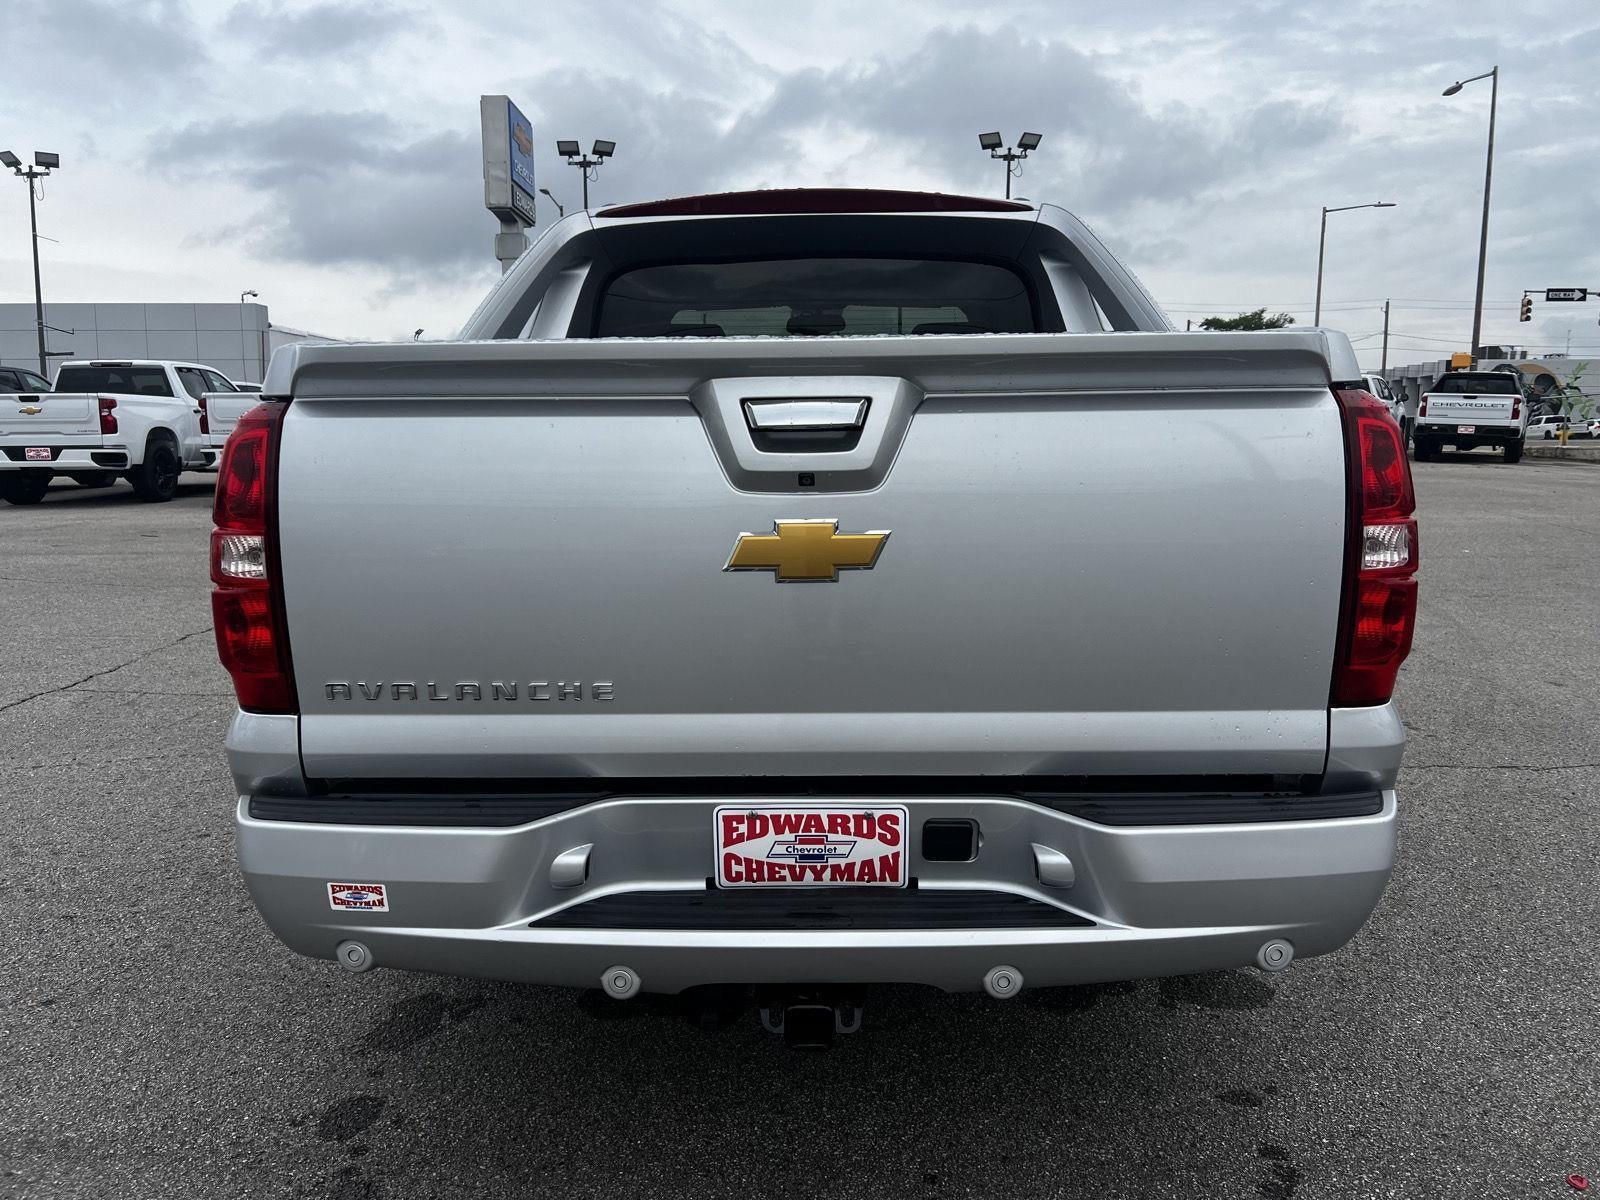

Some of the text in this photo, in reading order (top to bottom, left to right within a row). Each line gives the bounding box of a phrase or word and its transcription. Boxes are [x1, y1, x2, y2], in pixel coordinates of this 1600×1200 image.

[324, 682, 615, 701] AVALANCHE
[722, 813, 901, 848] EDWARDS
[785, 845, 838, 855] Chevrolet
[723, 850, 901, 883] CHEVYMAN
[330, 884, 384, 897] EDWARDS
[332, 895, 385, 907] CHEVYMAN
